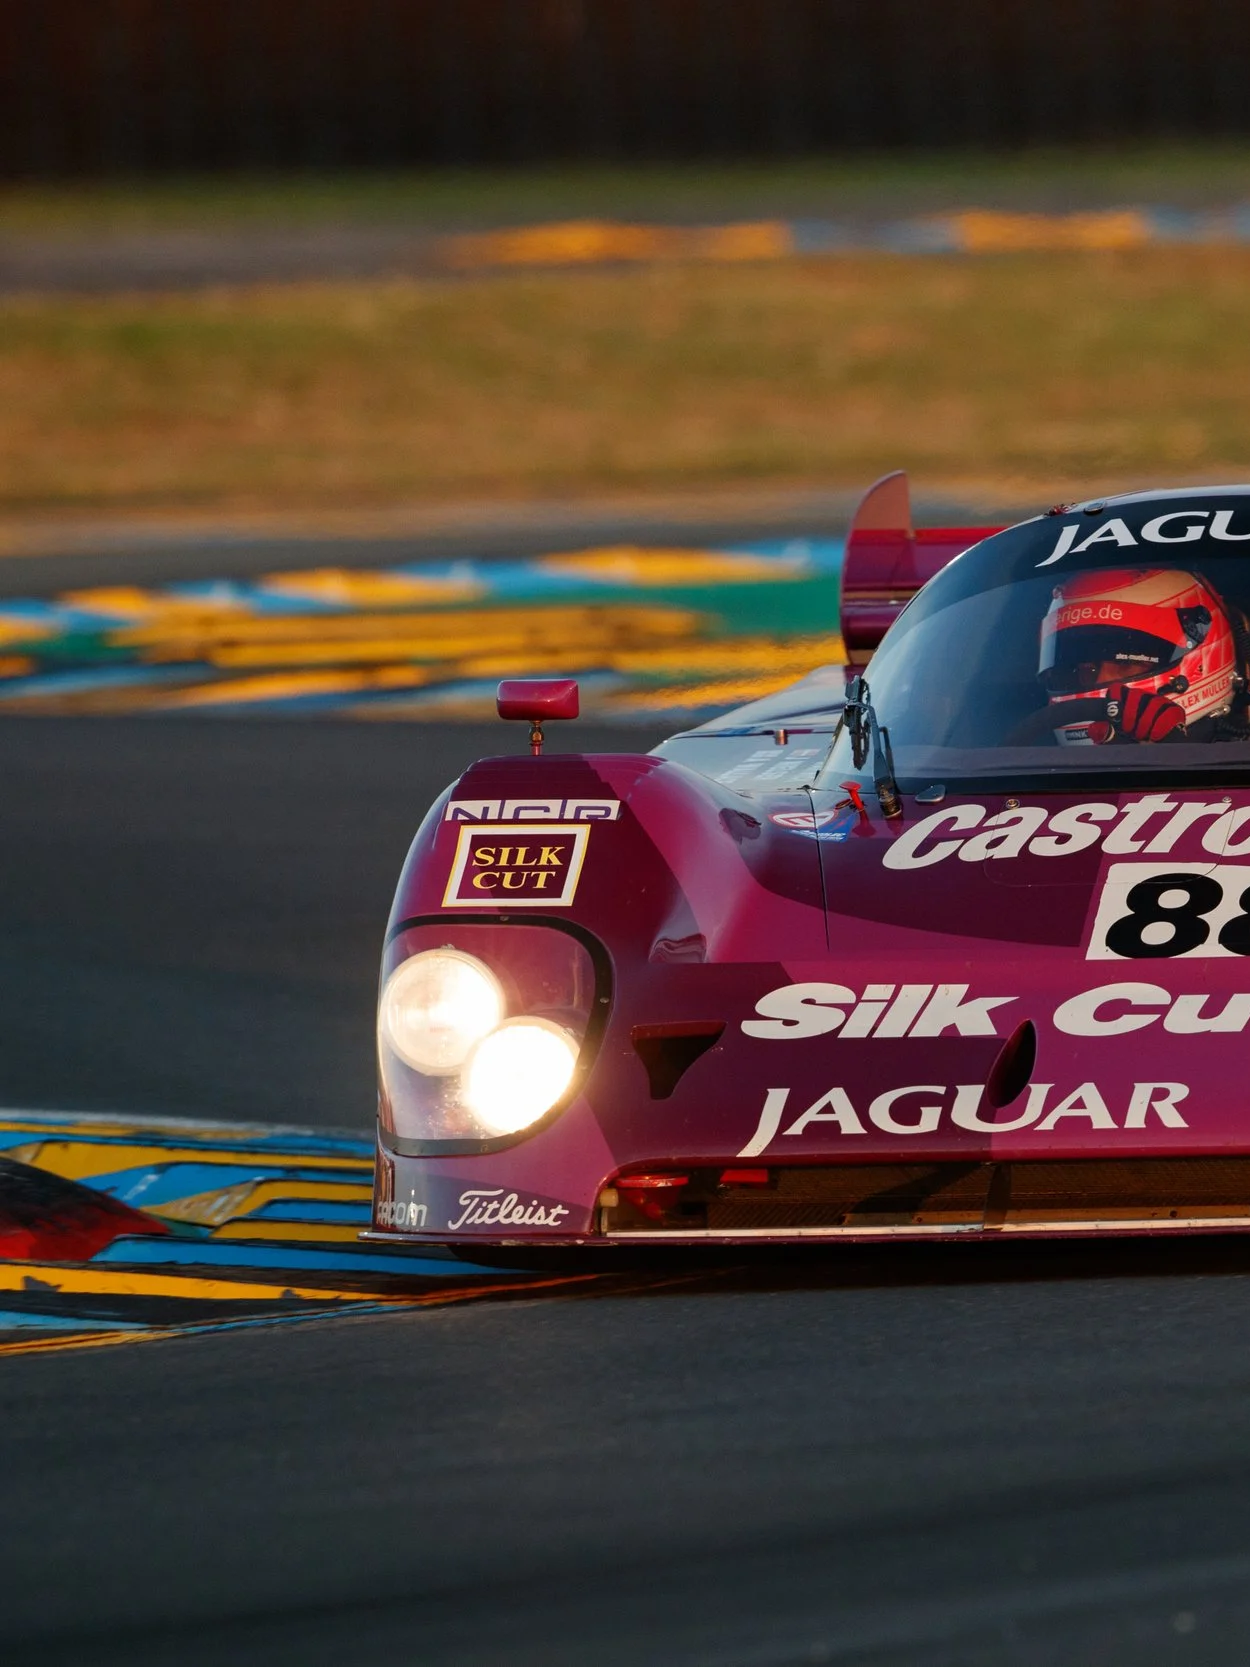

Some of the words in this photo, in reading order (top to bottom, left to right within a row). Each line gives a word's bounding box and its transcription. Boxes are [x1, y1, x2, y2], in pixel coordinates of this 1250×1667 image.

[471, 846, 565, 867] SILK
[472, 871, 556, 889] CUT
[740, 982, 1020, 1040] Silk
[736, 1082, 1190, 1158] JAGUAR
[447, 1189, 570, 1230] Titleist
